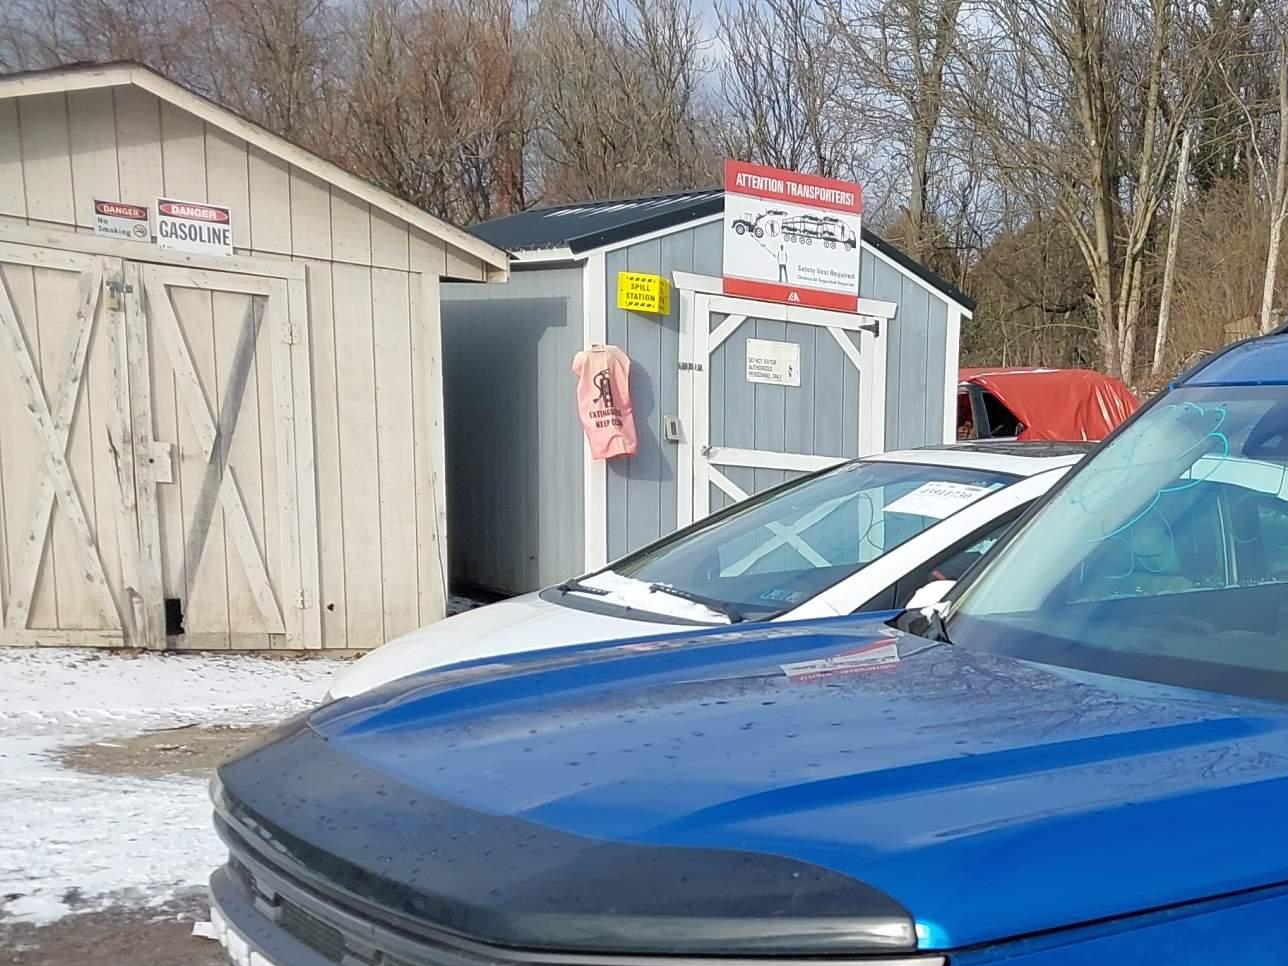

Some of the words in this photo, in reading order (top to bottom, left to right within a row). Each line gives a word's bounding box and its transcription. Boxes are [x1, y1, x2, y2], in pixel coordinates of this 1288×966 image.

[736, 173, 784, 194] ATTENTION
[785, 181, 855, 206] TRANSPORTERS!
[103, 204, 139, 217] DANGER
[171, 203, 217, 219] DANGER
[97, 217, 108, 225] No
[97, 225, 132, 238] Smoking
[160, 220, 231, 246] GASOLINE
[630, 283, 651, 292] SPILL
[625, 292, 656, 302] STATION
